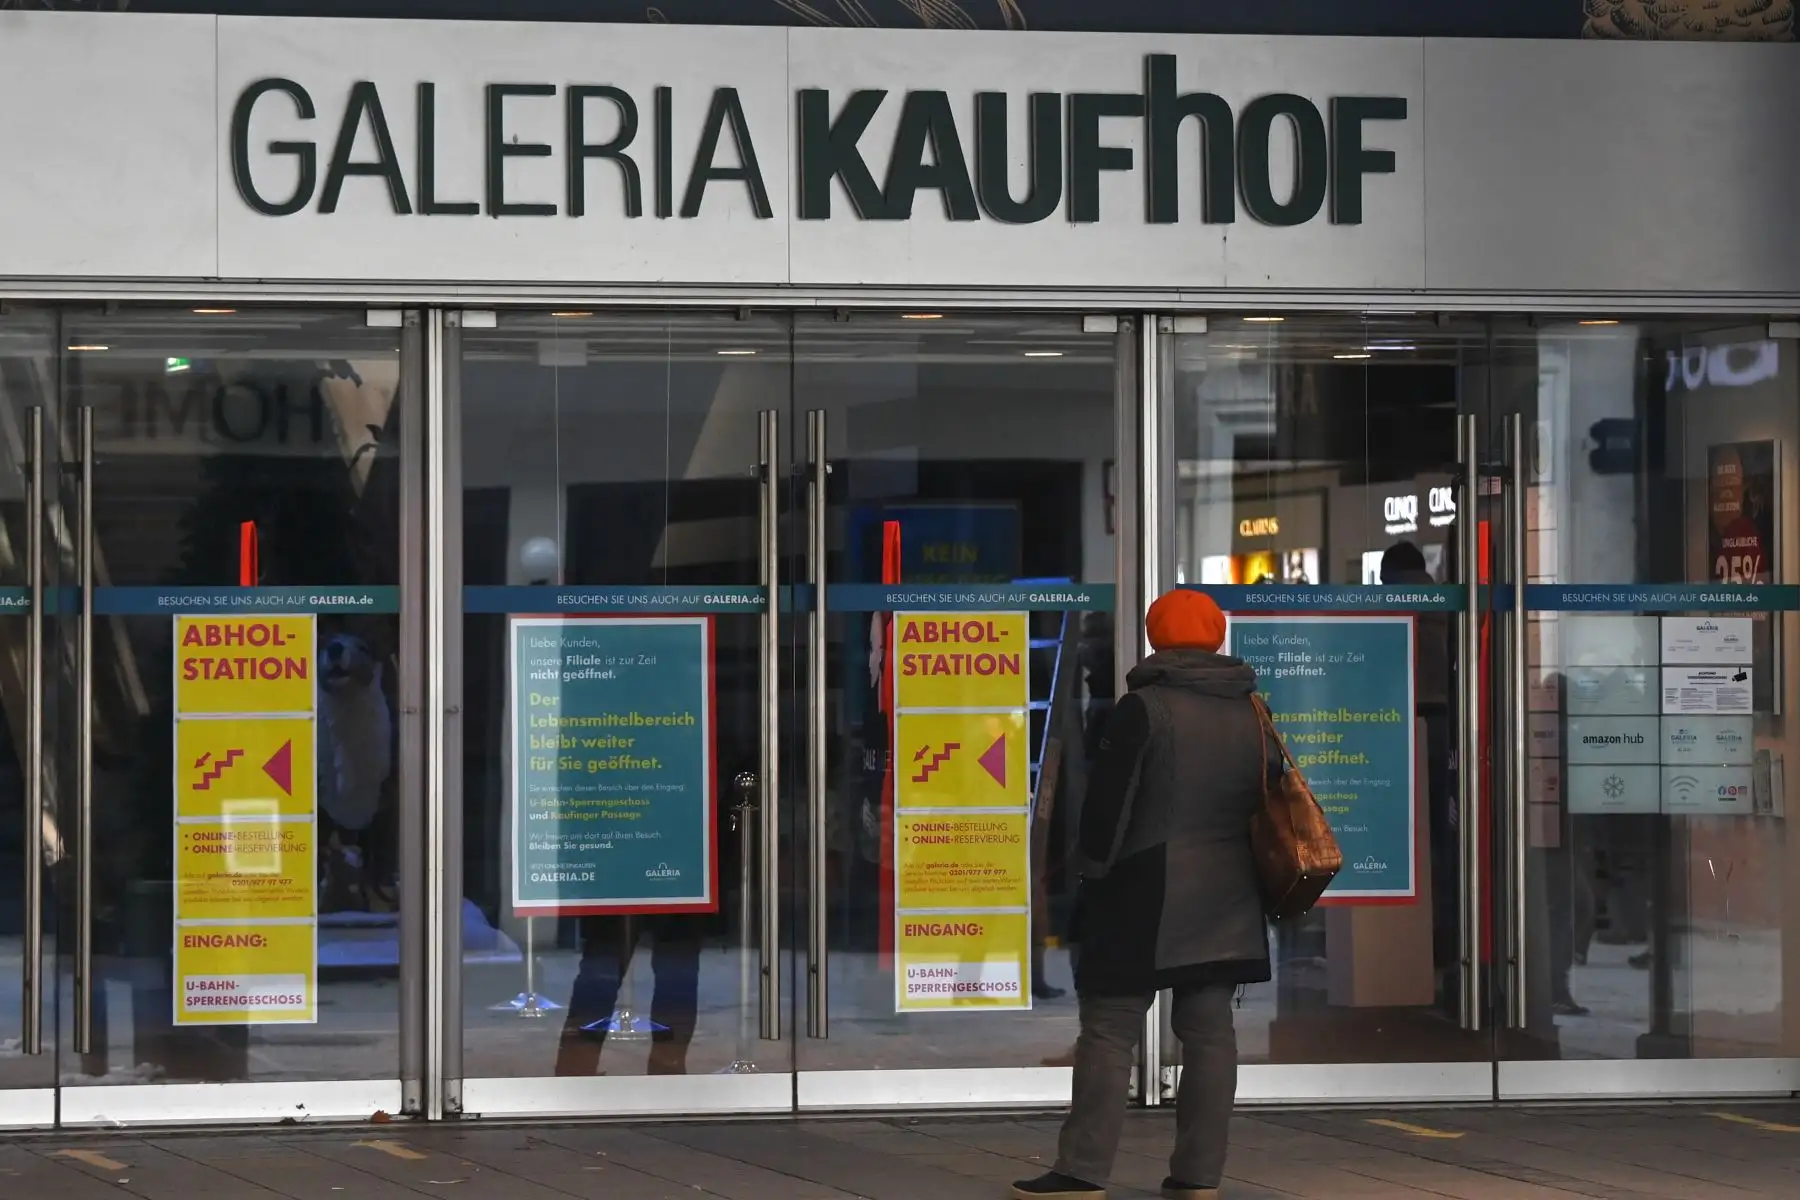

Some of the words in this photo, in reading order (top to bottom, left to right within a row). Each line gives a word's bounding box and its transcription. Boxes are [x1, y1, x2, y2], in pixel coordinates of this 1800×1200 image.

[231, 77, 773, 219] GALERIA
[158, 594, 210, 607] BESUCHEN
[214, 594, 228, 607] SIE
[231, 594, 252, 607] UNS
[255, 594, 284, 607] AUCH
[287, 594, 306, 607] AUF
[309, 594, 374, 607] GALERIA.de
[557, 594, 608, 605] BESUCHEN
[610, 594, 625, 605] SIE
[627, 594, 648, 605] UNS
[651, 594, 678, 605] AUCH
[682, 594, 701, 605] AUF
[703, 594, 766, 605] GALERIA.de
[886, 593, 937, 603] BESUCHEN
[939, 593, 952, 603] SIE
[955, 593, 975, 603] UNS
[978, 593, 1005, 603] AUCH
[1008, 593, 1027, 603] AUF
[1029, 593, 1090, 603] GALERIA.de
[1246, 593, 1295, 603] BESUCHEN
[1297, 593, 1310, 603] SIE
[1313, 593, 1332, 603] UNS
[1335, 593, 1361, 603] AUCH
[1364, 593, 1383, 603] AUF
[1385, 593, 1446, 603] GALERIA.de
[1562, 593, 1610, 603] BESUCHEN
[1613, 593, 1625, 603] SIE
[1628, 593, 1648, 603] UNS
[1650, 593, 1676, 603] AUCH
[1679, 593, 1697, 603] AUF
[1700, 593, 1759, 603] GALERIA.de
[182, 624, 296, 647] ABHOL-
[901, 621, 1009, 643] ABHOL-
[530, 637, 557, 648] Liebe
[560, 637, 601, 649] Kunden,
[1243, 635, 1269, 645] Liebe
[1272, 635, 1311, 646] Kunden,
[530, 658, 562, 667] unsere
[566, 655, 601, 665] Filiale
[605, 656, 615, 665] ist
[619, 657, 634, 666] zur
[638, 655, 657, 665] Zeit
[1243, 655, 1275, 663] unsere
[1278, 652, 1311, 663] Filiale
[1315, 654, 1325, 663] ist
[1328, 655, 1343, 663] zur
[1346, 653, 1365, 663] Zeit
[182, 657, 307, 681] STATION
[902, 653, 1020, 676] STATION
[530, 669, 559, 680] nicht
[563, 669, 616, 682] geöffnet.
[1275, 666, 1326, 678] geöffnet.
[530, 693, 560, 706] Der
[530, 712, 695, 728] Lebensmittelbereich
[530, 735, 577, 749] bleibt
[581, 735, 635, 749] weiter
[1291, 731, 1344, 743] weiter
[1583, 735, 1621, 744] amazon
[1623, 733, 1644, 744] hub
[530, 756, 554, 771] für
[559, 756, 583, 770] Sie
[588, 756, 663, 773] geöffnet.
[1298, 752, 1370, 768] geöffnet.
[529, 811, 549, 820] und
[550, 811, 599, 821] Kaufinger
[601, 810, 641, 821] Passage
[912, 822, 1008, 832] ONLINE-BESTELLUNG
[192, 831, 294, 841] ONLINE-BESTELLUNG
[584, 831, 600, 839] dort
[912, 834, 1020, 845] ONLINE-RESERVIERUNG
[192, 843, 307, 854] ONLINE-RESERVIERUNG
[529, 842, 561, 850] Bleiben
[563, 841, 578, 849] Sie
[579, 841, 614, 851] gesund.
[1353, 862, 1388, 870] GALERIA
[531, 872, 596, 882] GALERIA.DE
[645, 869, 681, 877] GALERIA
[904, 923, 984, 937] EINGANG:
[183, 934, 268, 948] EINGANG:
[907, 968, 958, 978] U-BAHN-
[186, 980, 240, 991] U-BAHN-
[907, 982, 1018, 993] SPERRENGESCHOSS
[186, 994, 303, 1006] SPERRENGESCHOSS
